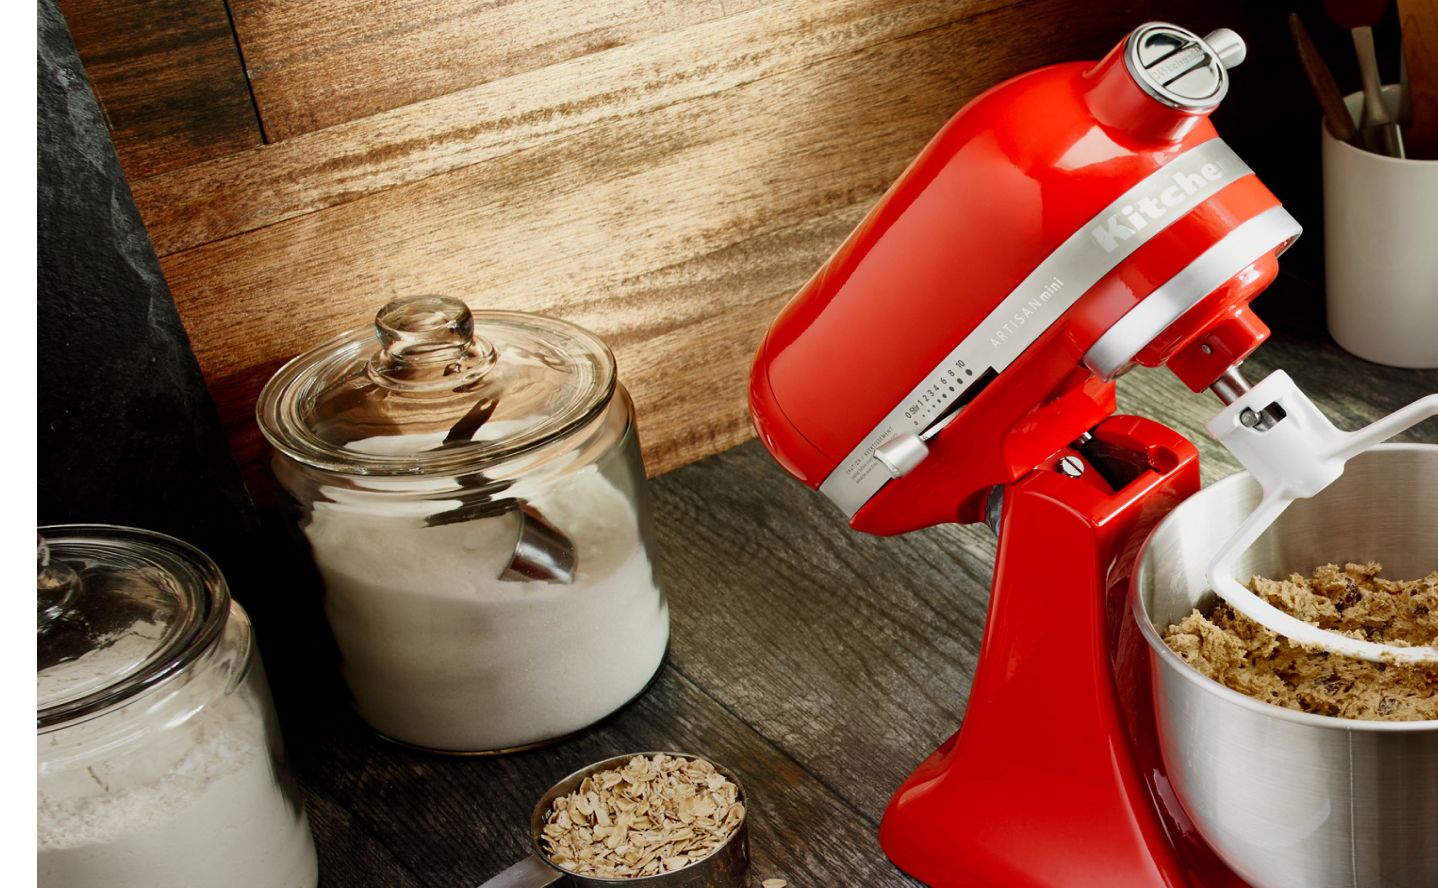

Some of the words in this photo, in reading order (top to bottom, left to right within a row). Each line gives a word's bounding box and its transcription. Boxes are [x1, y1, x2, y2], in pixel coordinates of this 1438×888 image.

[1091, 162, 1222, 252] Kitche
[990, 298, 1041, 348] ARTISAN
[1040, 276, 1064, 302] mini
[927, 389, 935, 397] 3
[940, 377, 948, 385] 6
[955, 360, 965, 368] 10
